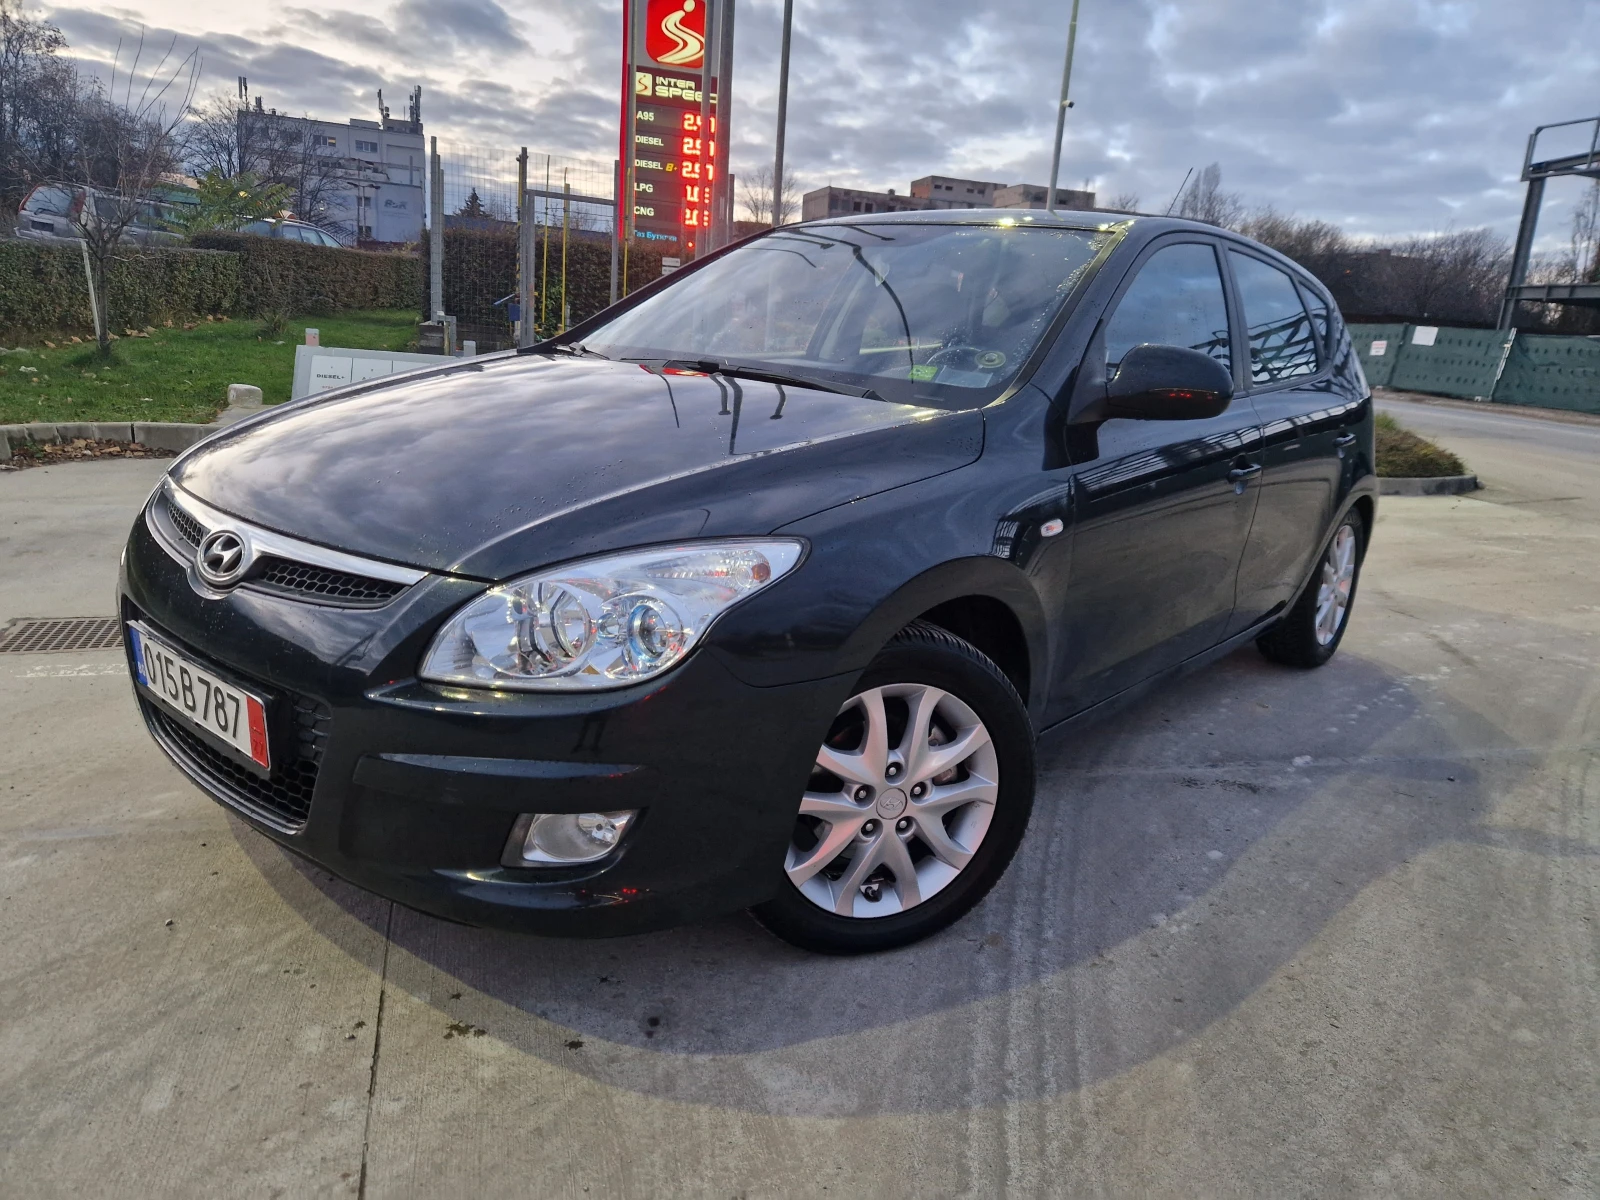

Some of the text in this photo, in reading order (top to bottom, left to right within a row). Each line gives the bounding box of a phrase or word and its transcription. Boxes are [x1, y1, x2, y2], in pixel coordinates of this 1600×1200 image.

[655, 76, 695, 89] INTER
[636, 111, 654, 121] A95
[635, 135, 664, 146] DIESEL
[634, 159, 663, 170] DIESEL
[634, 183, 653, 193] LPG
[634, 206, 654, 216] CNG
